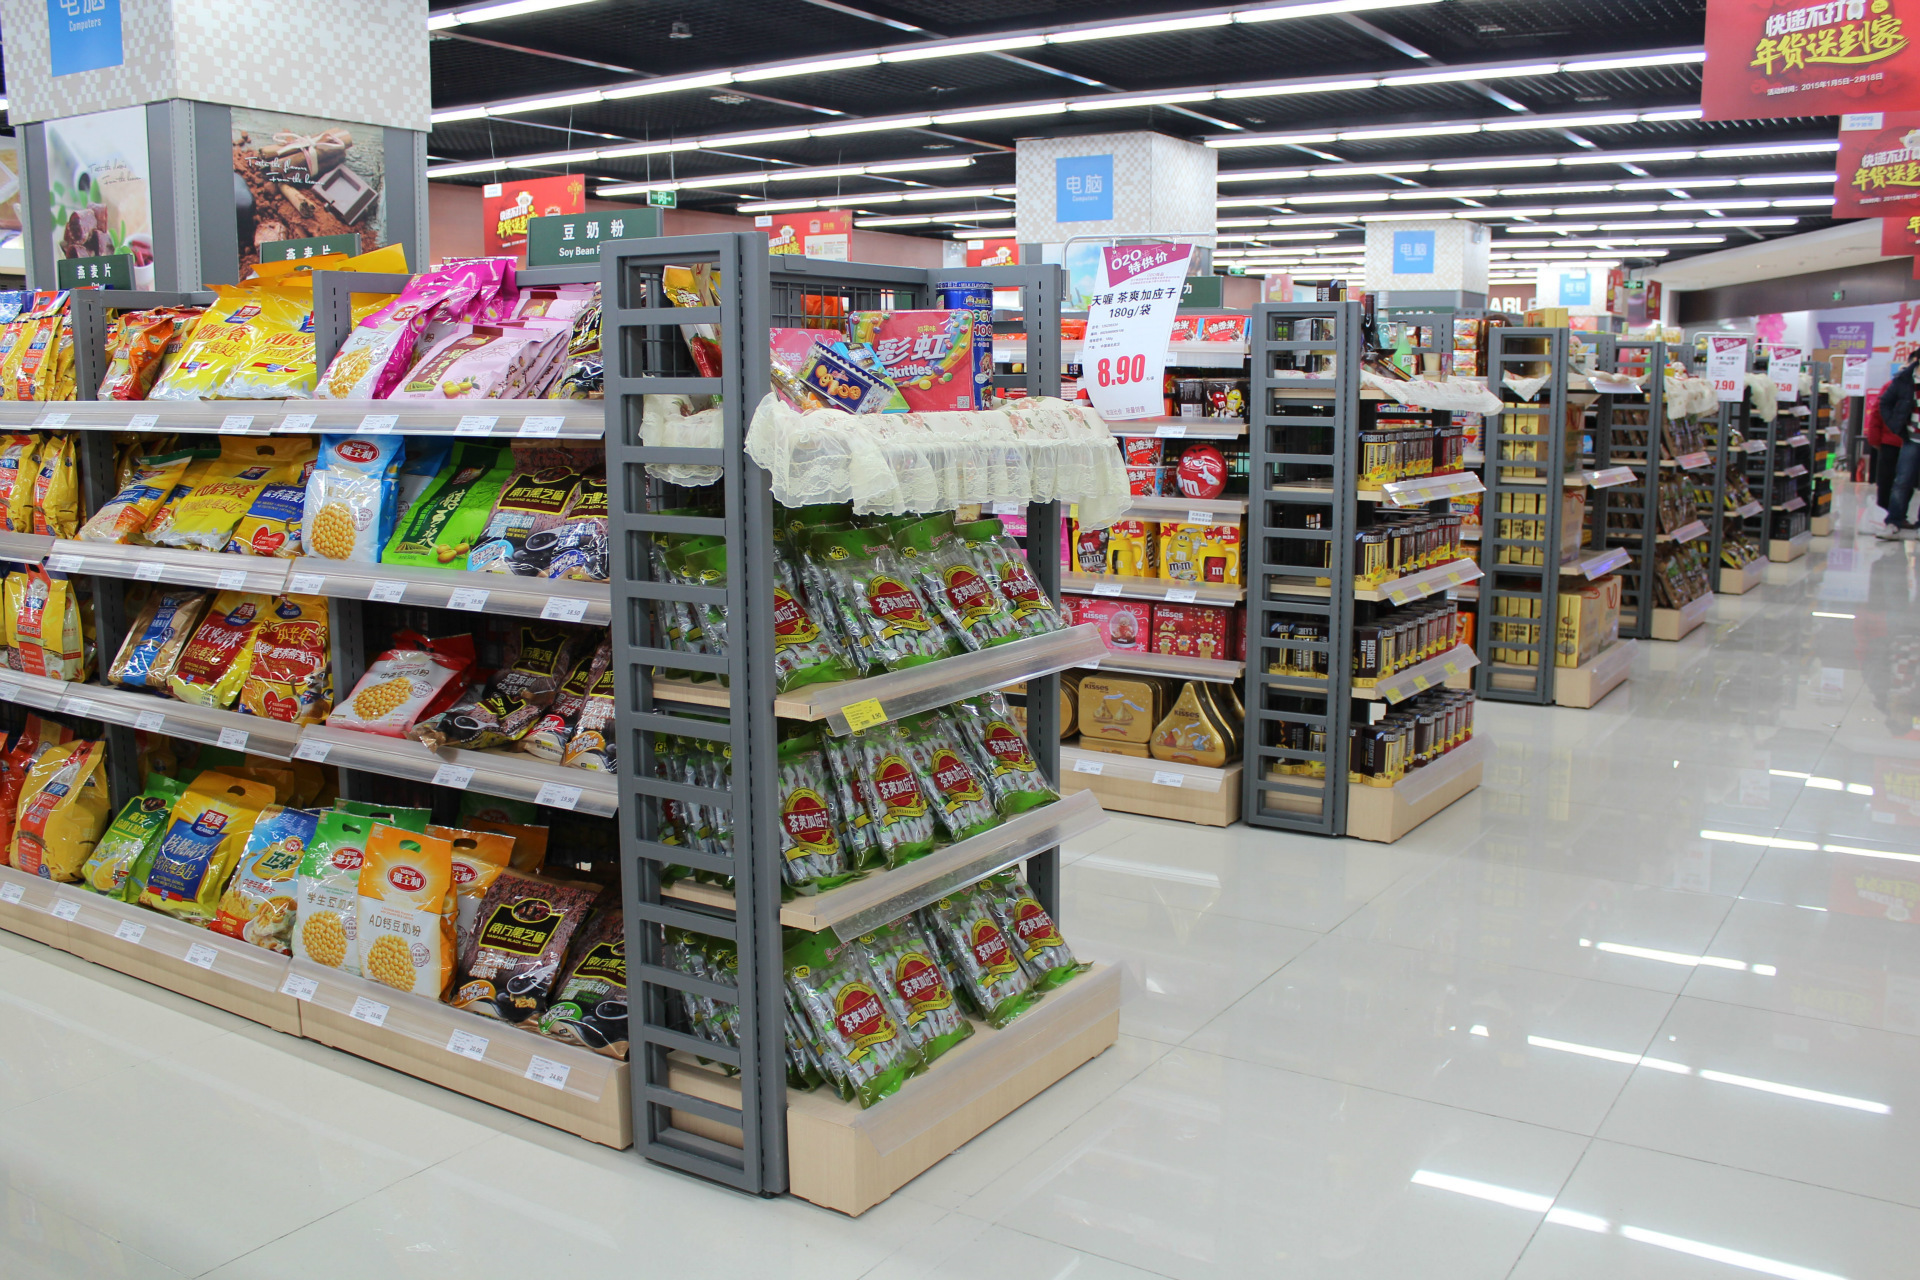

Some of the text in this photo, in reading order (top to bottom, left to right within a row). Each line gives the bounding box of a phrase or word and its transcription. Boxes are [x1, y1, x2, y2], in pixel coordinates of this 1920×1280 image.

[1751, 14, 1909, 75] 年货送到家
[1065, 174, 1102, 194] 电脑
[563, 219, 624, 240] 豆奶粉
[559, 247, 574, 258] Soy
[575, 245, 595, 256] Bean
[1400, 243, 1427, 256] 电脑
[1112, 250, 1142, 270] O2O
[1128, 251, 1168, 275] 特供价
[77, 264, 112, 280] 燕麦片
[1091, 287, 1177, 307] 天喔 茶爽加应子
[1109, 303, 1152, 319] 180g/袋
[876, 333, 951, 366] 彩虹
[888, 363, 932, 380] Skittles
[1097, 354, 1146, 387] 8.90
[1714, 380, 1735, 391] 7.90
[509, 487, 566, 500] 南方黑芝麻
[1183, 478, 1201, 497] m
[1211, 565, 1224, 576] m
[951, 576, 987, 604] 茶爽加应子
[875, 593, 920, 614] 茶爽加应子
[989, 738, 1024, 754] 茶爽加应子
[878, 773, 917, 799] 茶爽加应子
[204, 811, 227, 826] 西麦
[787, 810, 828, 832] 茶爽加应子
[393, 872, 421, 888] 雅士利
[307, 892, 355, 911] 学生豆奶粉
[369, 914, 421, 937] AD钙豆奶粉
[488, 922, 547, 943] 南方黑芝麻
[1019, 912, 1053, 936] 茶爽加应子
[976, 933, 1008, 961] 茶爽加应子
[900, 968, 938, 998] 茶爽加应子
[840, 997, 882, 1033] 茶爽加应子
[865, 1032, 888, 1044] PRESERVED
